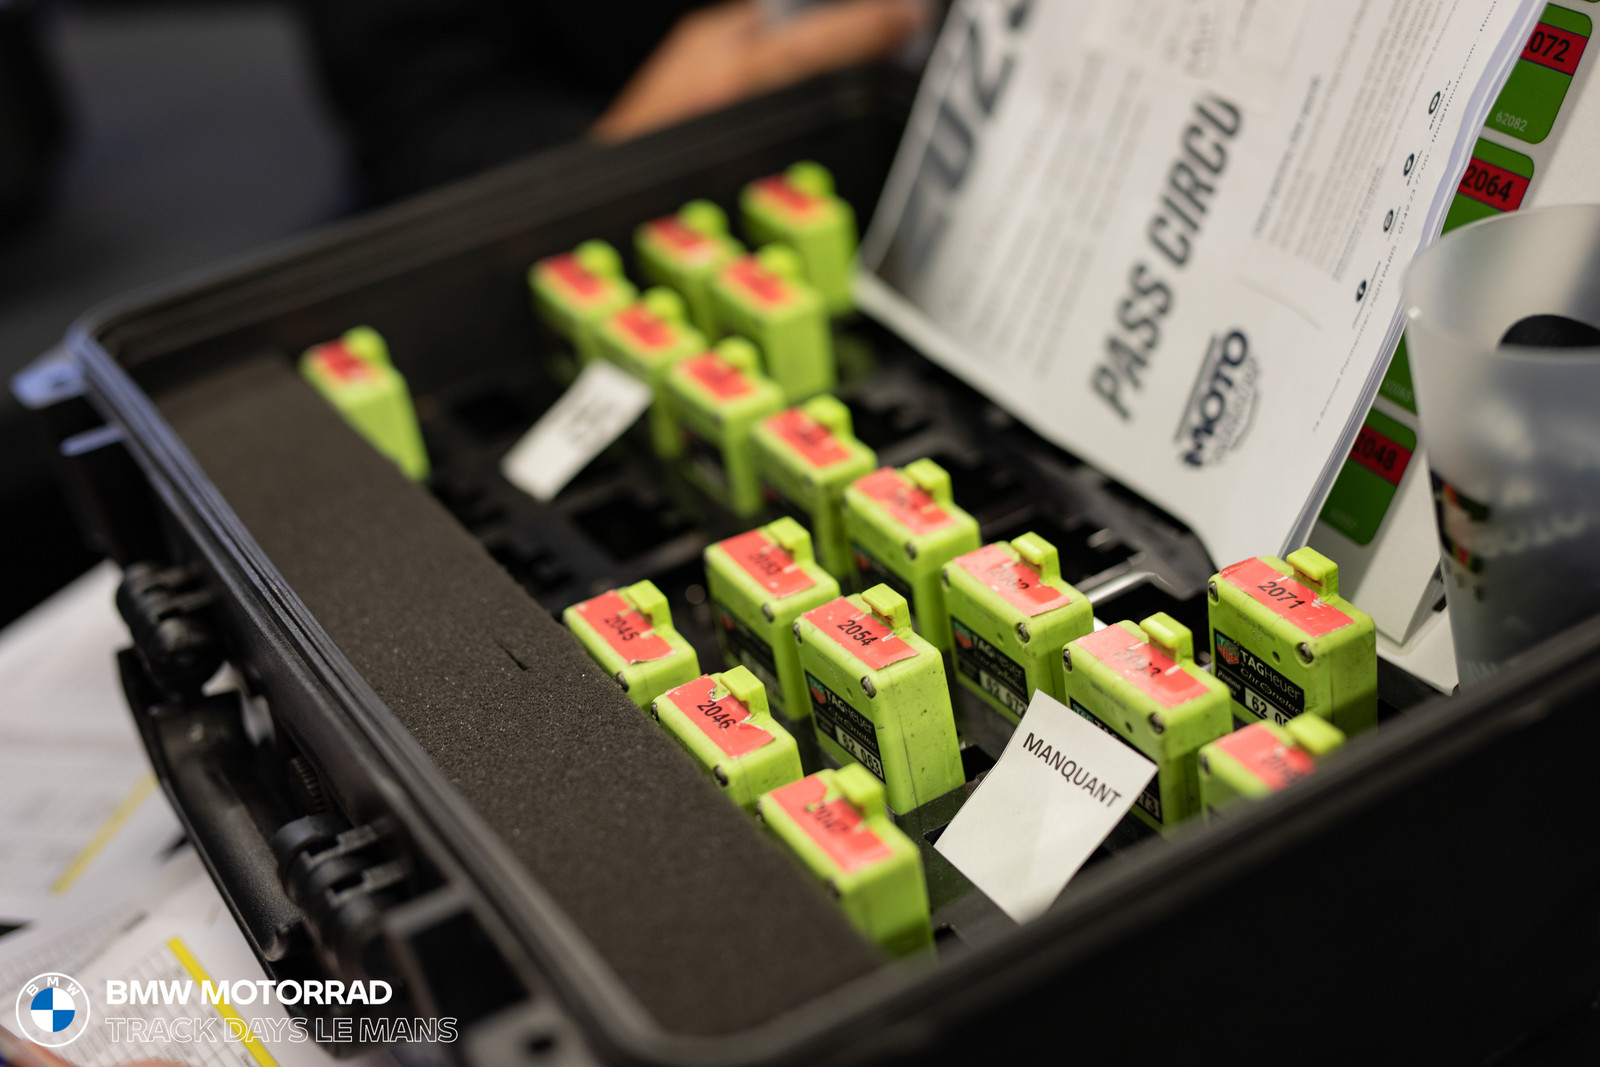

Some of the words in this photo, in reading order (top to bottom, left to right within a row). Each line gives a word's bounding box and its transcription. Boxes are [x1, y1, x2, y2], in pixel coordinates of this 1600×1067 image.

[1523, 31, 1570, 63] 072
[1462, 165, 1513, 202] 2064
[1089, 261, 1173, 422] PASS
[1181, 328, 1250, 470] MOTO
[1257, 580, 1306, 609] 2071
[603, 614, 640, 642] 2045
[837, 619, 879, 646] 2054
[696, 699, 737, 729] 2046
[1251, 695, 1268, 720] 62
[1022, 732, 1123, 808] MANQUANT
